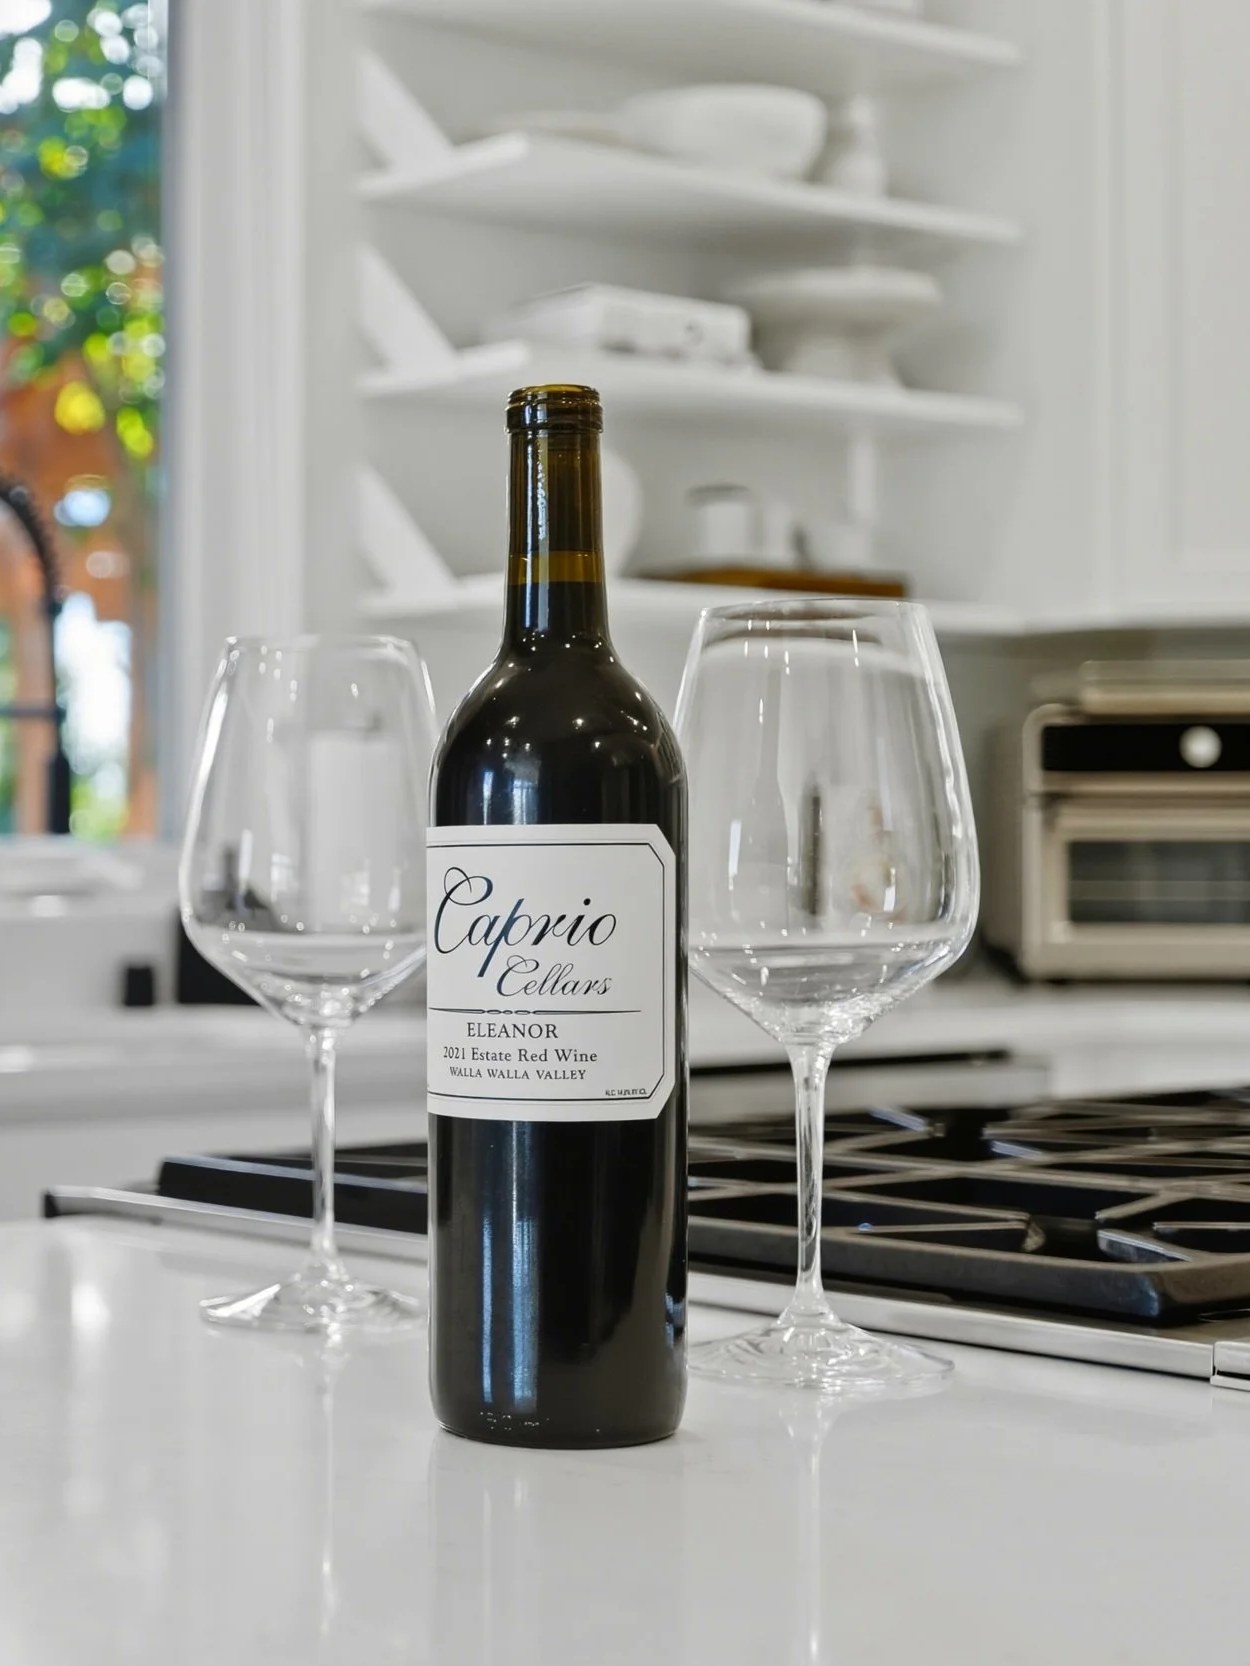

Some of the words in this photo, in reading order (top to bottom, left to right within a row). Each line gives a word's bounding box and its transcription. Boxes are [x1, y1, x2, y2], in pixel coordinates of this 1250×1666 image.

[434, 866, 617, 978] Caprio
[496, 955, 612, 997] Cellars
[466, 1022, 559, 1039] ELEANOR
[443, 1046, 466, 1060] 2021
[471, 1047, 512, 1062] Estate
[518, 1048, 548, 1062] Red
[555, 1048, 598, 1062] Wine
[449, 1067, 482, 1079] WALLA
[487, 1068, 529, 1080] WALLA
[536, 1069, 587, 1080] VALLEY
